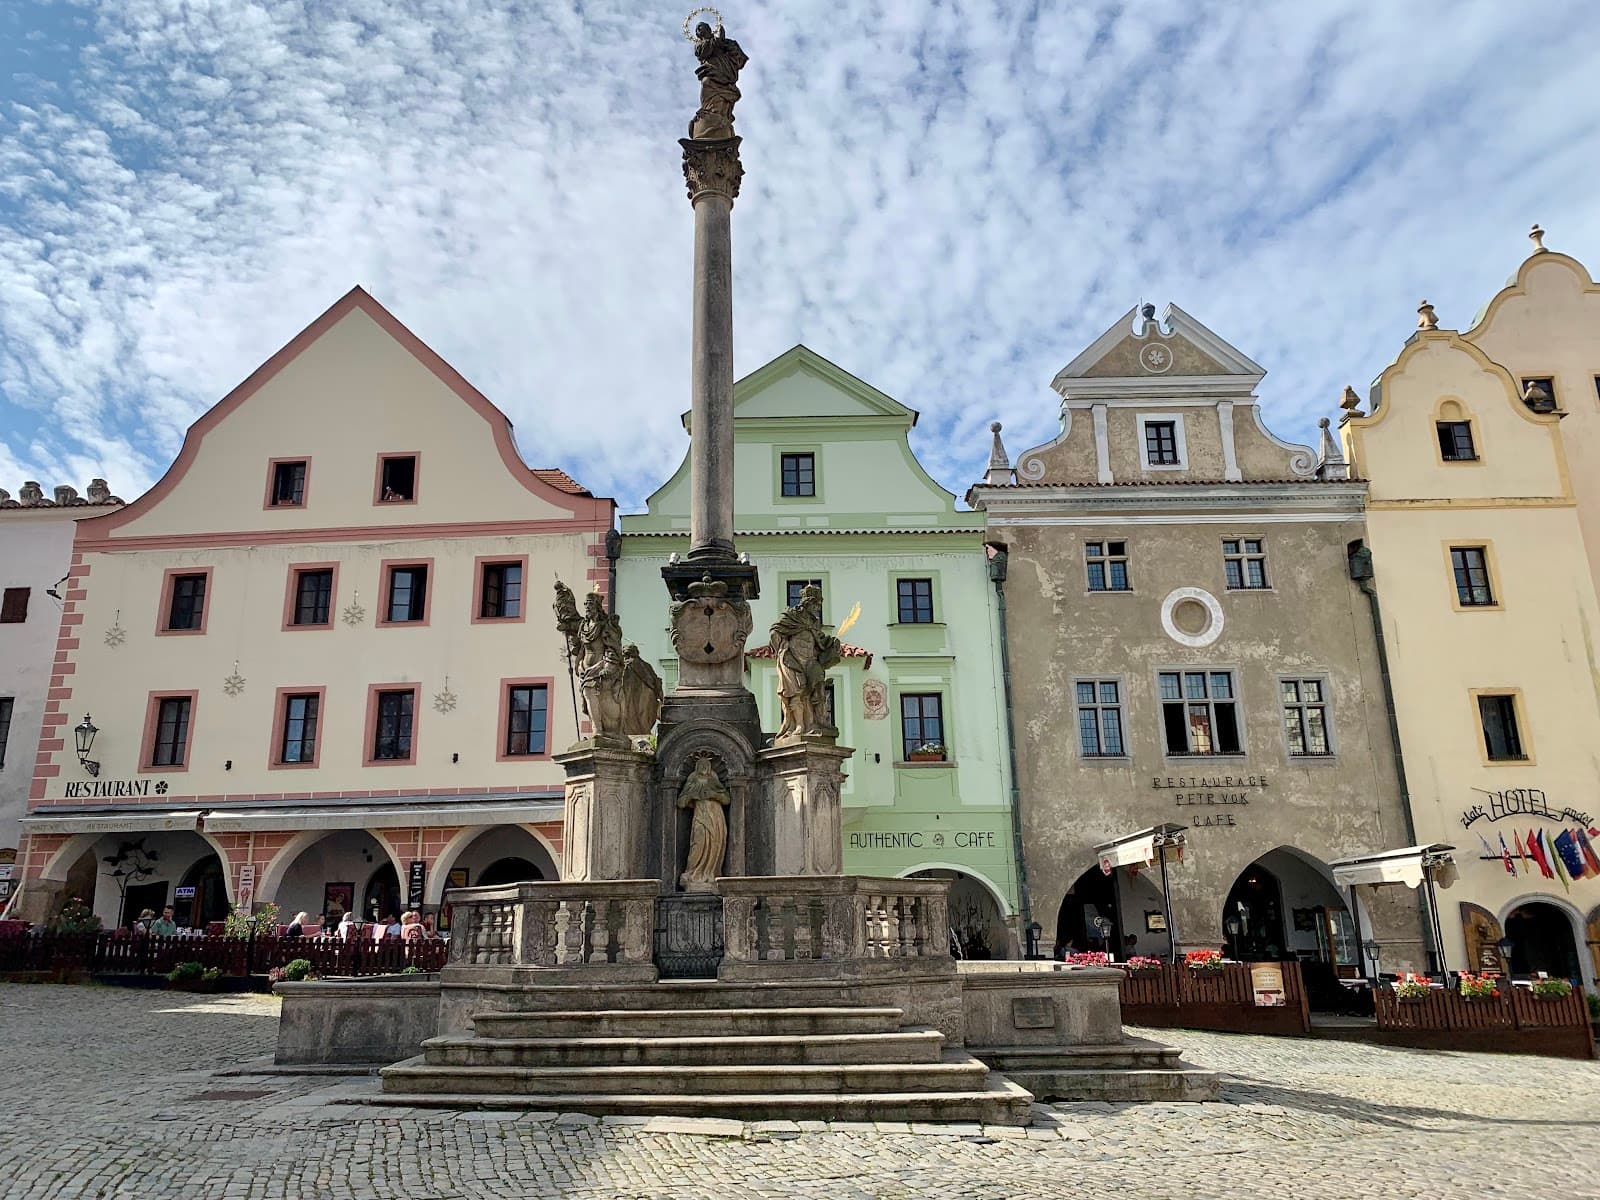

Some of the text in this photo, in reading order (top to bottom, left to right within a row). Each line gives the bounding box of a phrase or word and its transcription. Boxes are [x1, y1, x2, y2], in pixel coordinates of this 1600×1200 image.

[65, 779, 151, 798] RESTAURANT
[1176, 793, 1249, 806] PETR VOK
[1488, 788, 1557, 820] HOTEL
[1192, 814, 1237, 827] CAFE
[850, 831, 996, 849] AUTHENTIC CAFE
